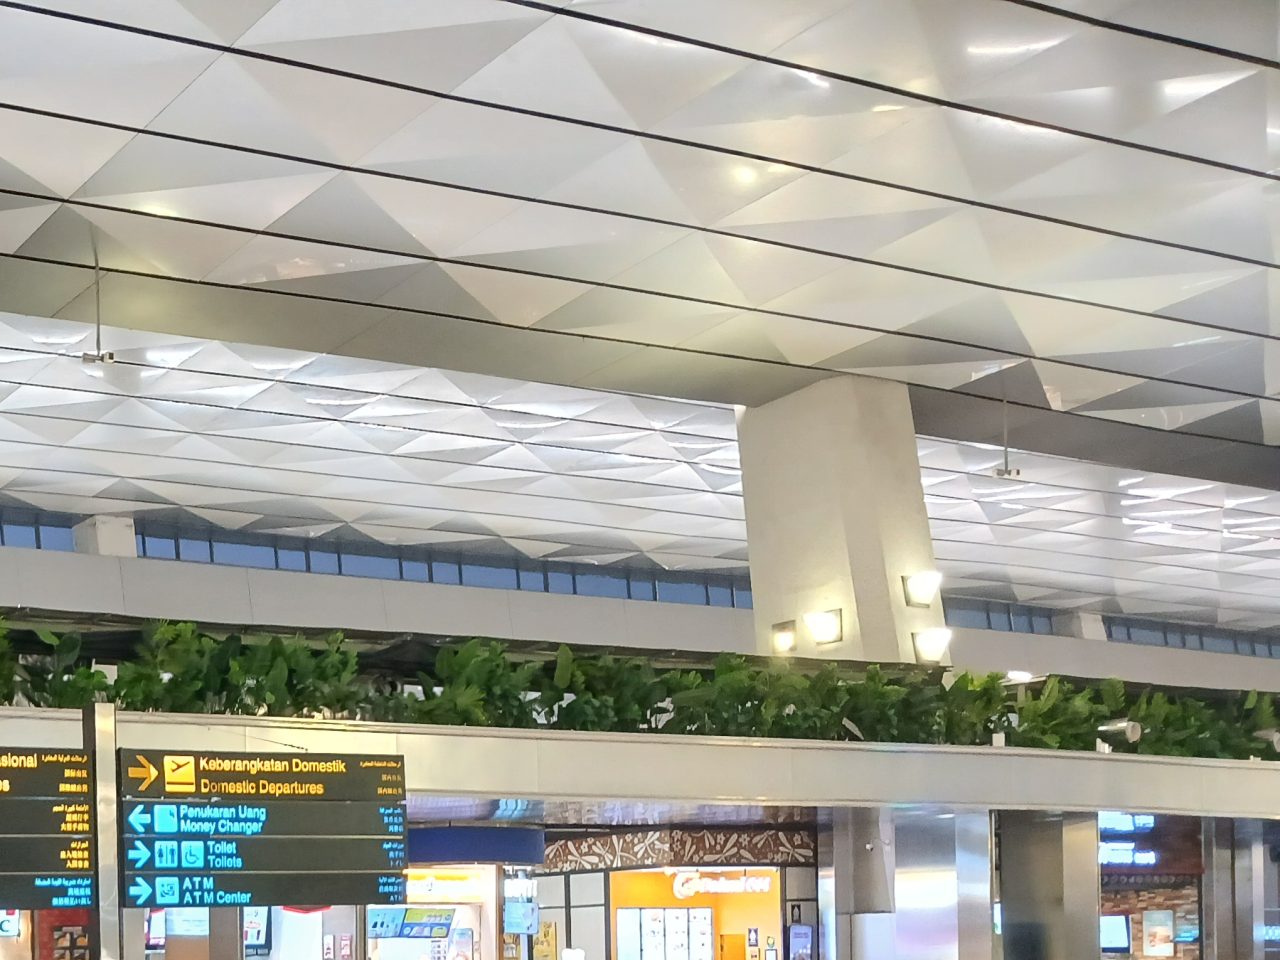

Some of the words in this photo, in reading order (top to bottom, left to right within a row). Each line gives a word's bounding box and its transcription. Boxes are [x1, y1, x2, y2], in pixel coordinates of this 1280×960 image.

[200, 757, 289, 773] Keberangkatan
[292, 760, 346, 772] Domestik
[201, 779, 256, 793] Domestic
[259, 780, 324, 796] Departures
[180, 805, 236, 818] Penukaran
[239, 807, 266, 821] Uang
[180, 820, 215, 834] Money
[218, 820, 263, 834] Changer
[208, 841, 236, 854] Toilet
[208, 856, 242, 868] Toilets
[217, 891, 251, 903] Center
